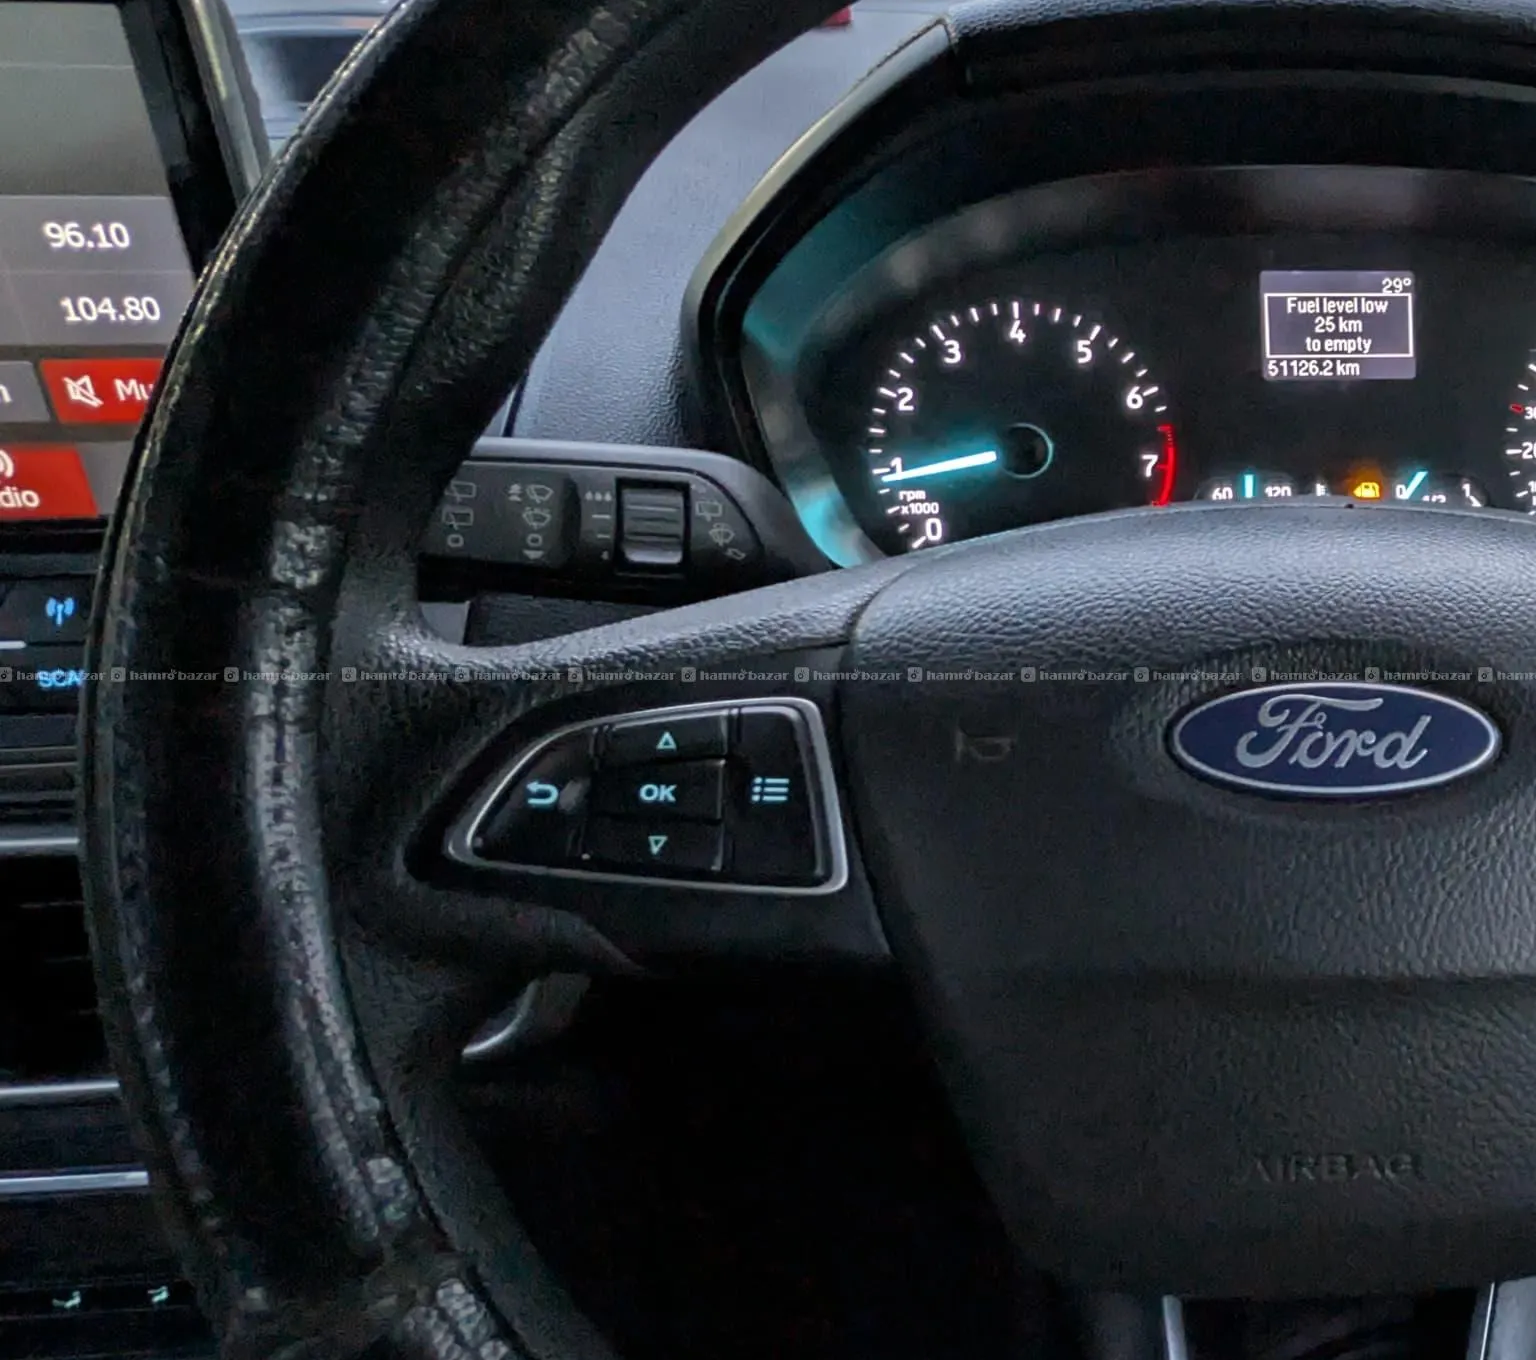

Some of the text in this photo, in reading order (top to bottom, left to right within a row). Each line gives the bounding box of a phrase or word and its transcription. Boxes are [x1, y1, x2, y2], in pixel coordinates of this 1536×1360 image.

[43, 221, 131, 250] 96.10
[60, 296, 161, 323] 104.80
[1286, 297, 1389, 314] Fuel level low
[1009, 319, 1026, 342] 4
[1314, 316, 1363, 333] 25 km
[943, 340, 961, 365] 3
[1076, 340, 1093, 364] 5
[1306, 336, 1372, 355] to empty
[1267, 360, 1361, 377] 51126.2 km
[897, 387, 914, 411] 2
[1125, 385, 1144, 409] 6
[1141, 454, 1158, 478] 7
[898, 489, 927, 502] rpm
[900, 501, 940, 515] x1000
[925, 517, 943, 542] 0
[1236, 693, 1432, 769] Ford
[638, 783, 676, 802] OK
[1243, 1152, 1421, 1182] AIRBAG
